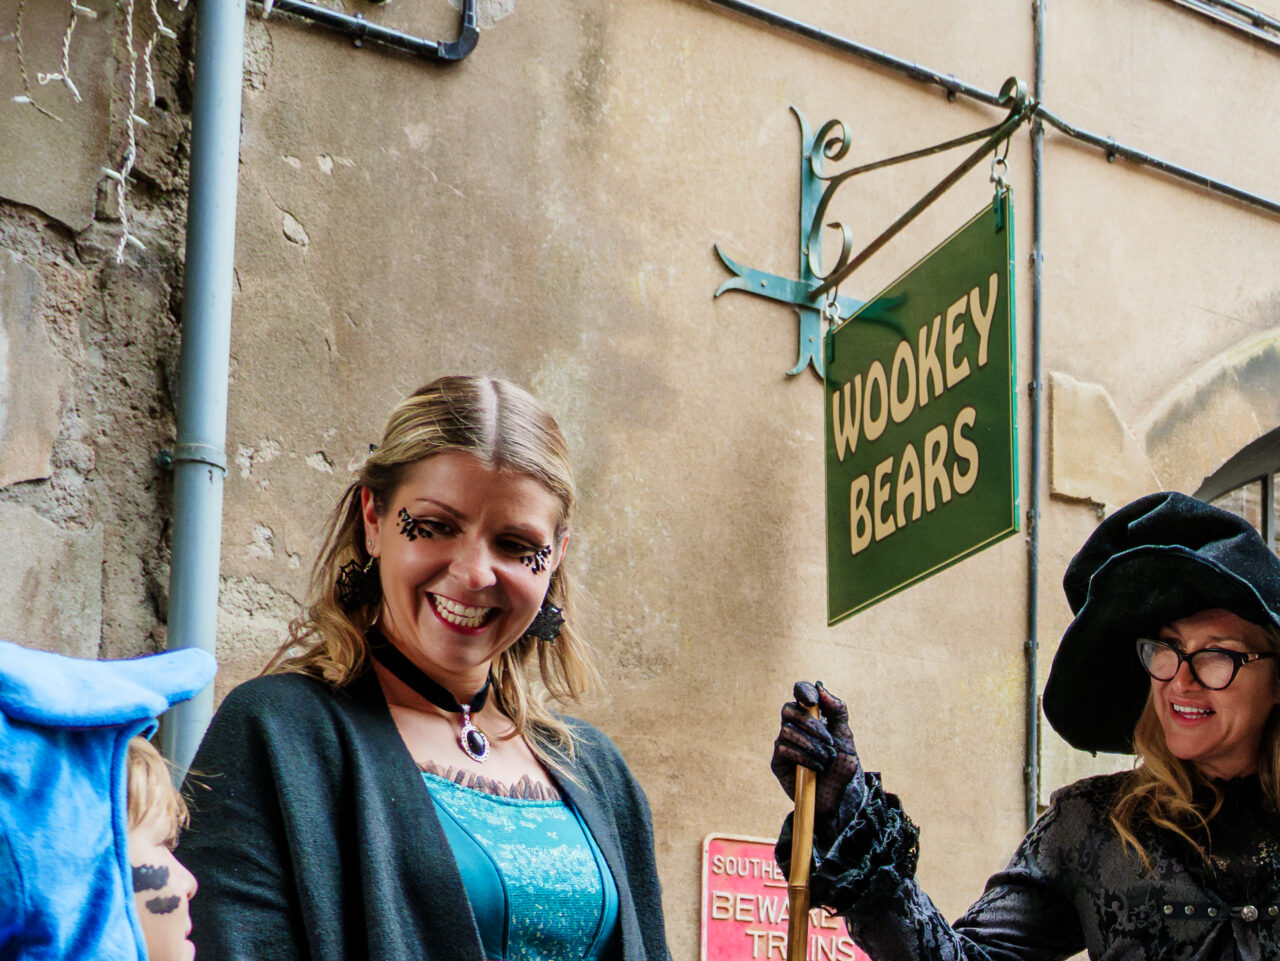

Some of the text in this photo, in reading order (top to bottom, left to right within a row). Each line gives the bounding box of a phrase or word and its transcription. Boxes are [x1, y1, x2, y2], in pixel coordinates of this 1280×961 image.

[832, 272, 999, 463] WOOKEY
[850, 406, 979, 556] BEARS
[712, 854, 783, 881] SOUTHE
